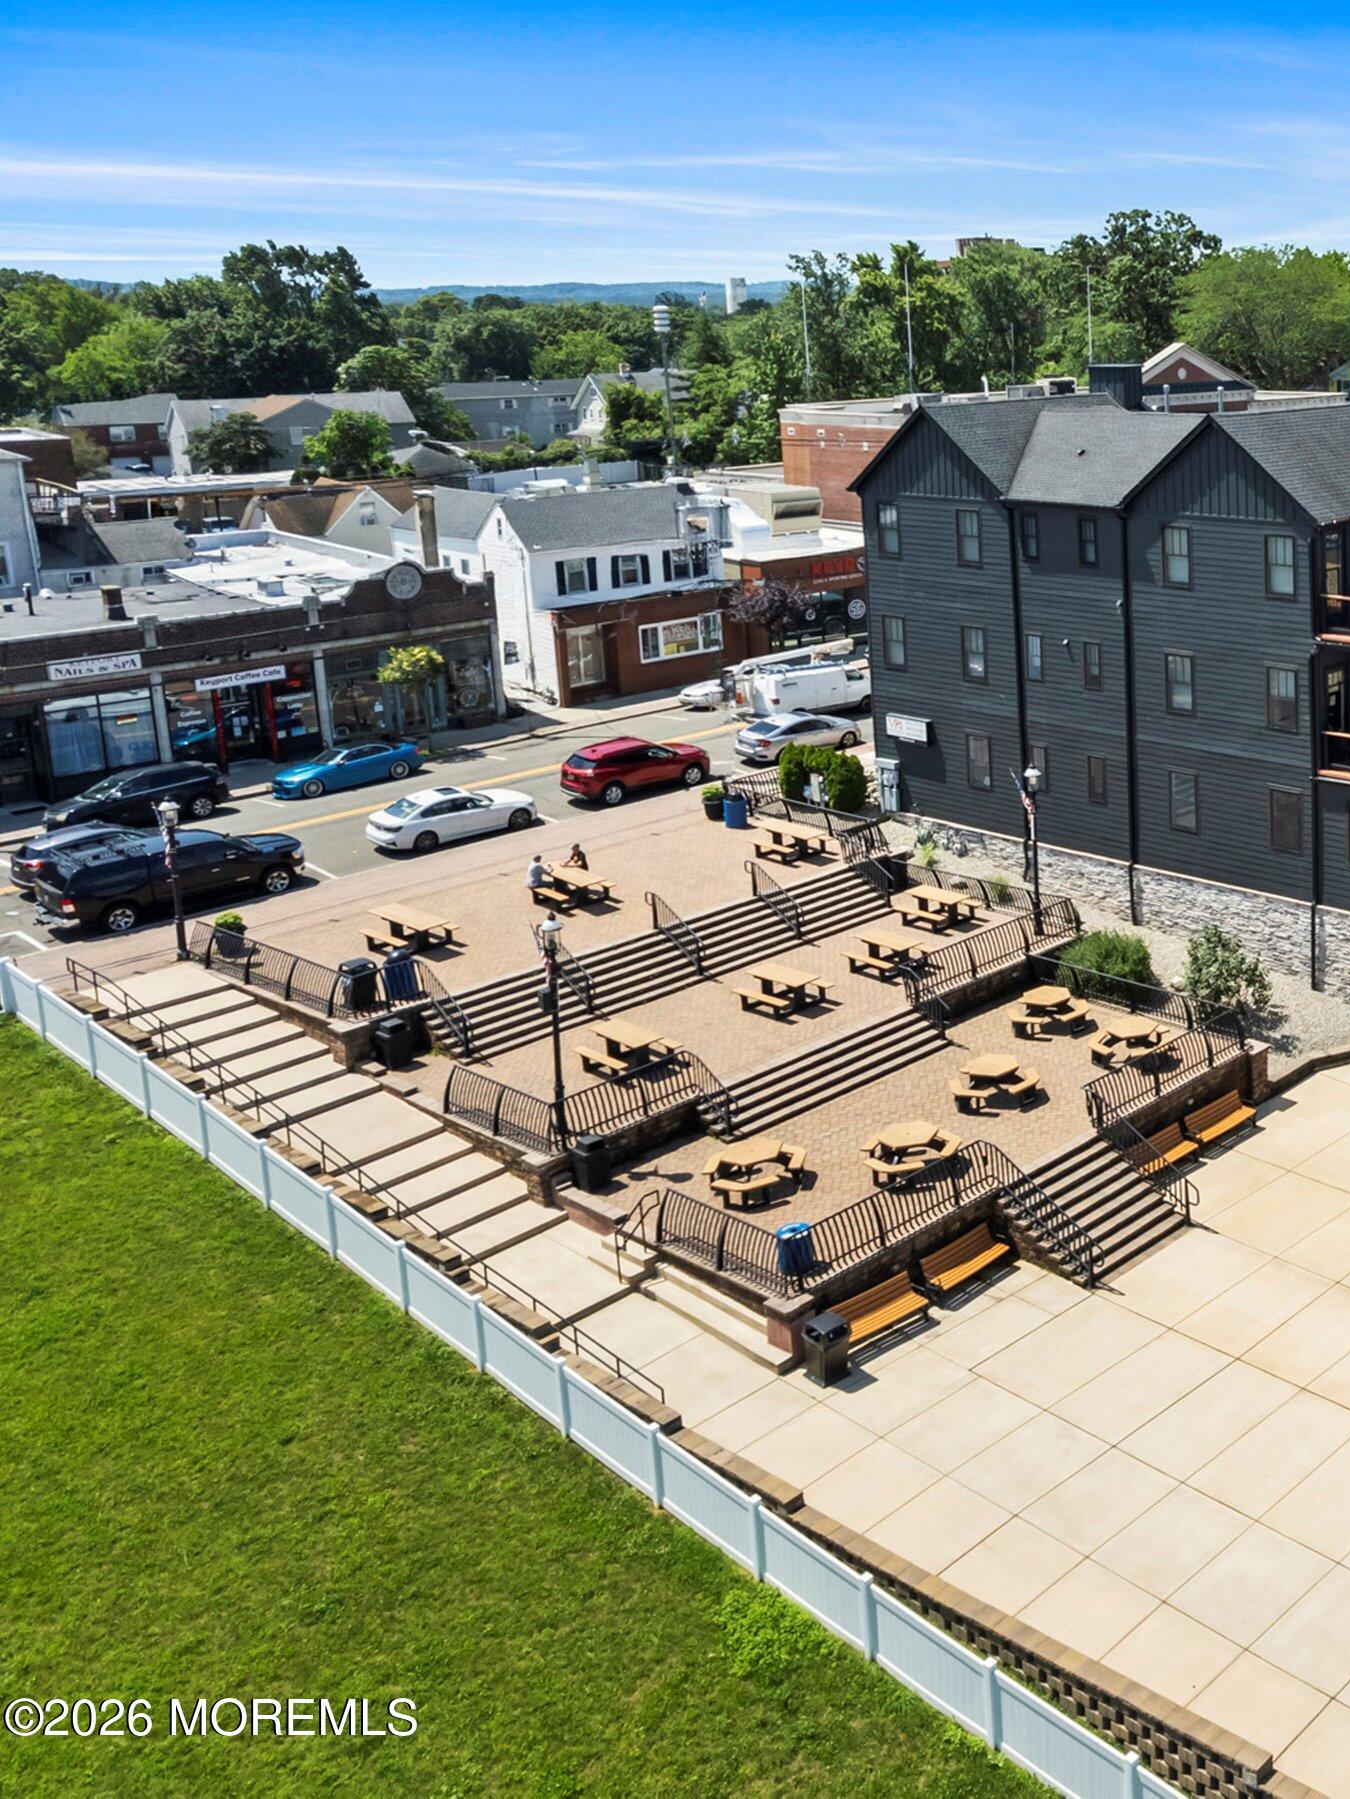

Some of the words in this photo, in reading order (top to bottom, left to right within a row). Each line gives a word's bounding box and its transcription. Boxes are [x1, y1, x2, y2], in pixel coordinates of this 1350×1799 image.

[200, 675, 233, 688] Keyport
[234, 671, 262, 682] Coffee
[263, 668, 282, 678] Cafe
